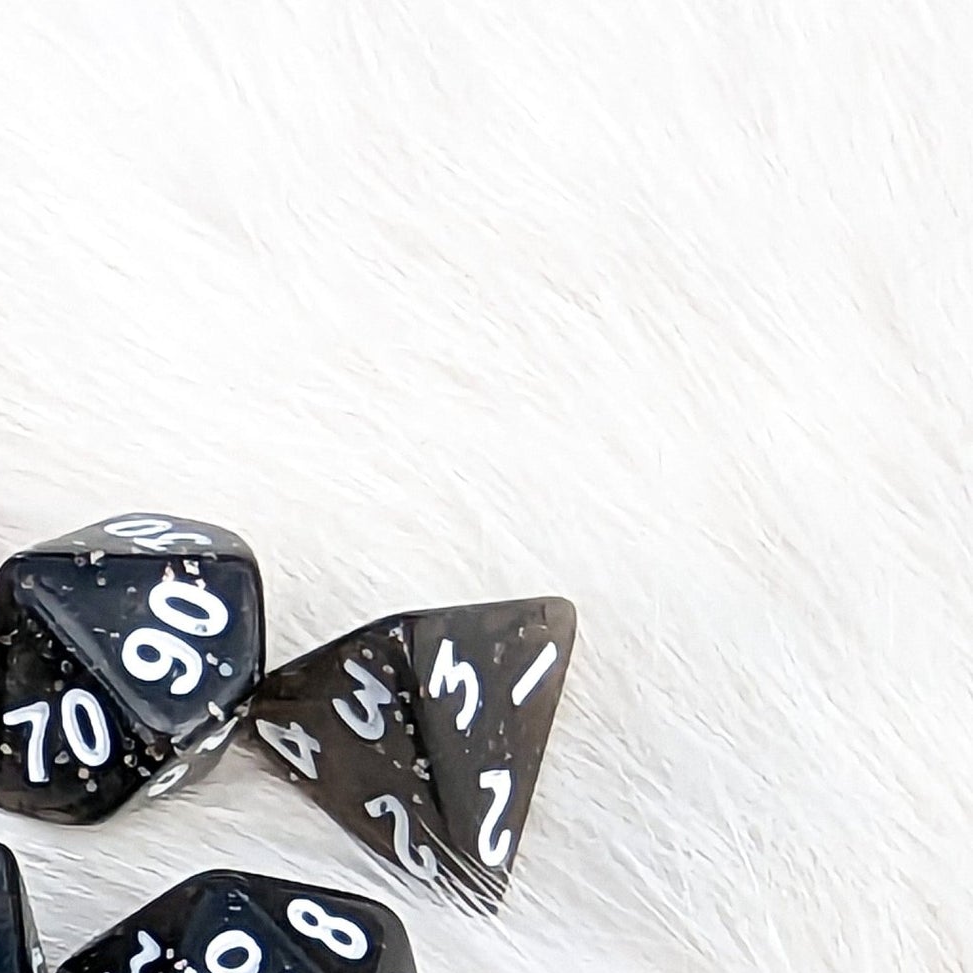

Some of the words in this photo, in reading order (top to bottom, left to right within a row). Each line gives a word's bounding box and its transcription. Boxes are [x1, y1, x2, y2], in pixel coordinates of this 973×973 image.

[121, 581, 229, 695] 90
[512, 641, 558, 706] 1
[331, 658, 392, 740] 3
[429, 638, 479, 730] 3
[2, 688, 111, 783] 70
[256, 719, 321, 780] 4
[478, 769, 512, 867] 2
[286, 898, 368, 961] 8
